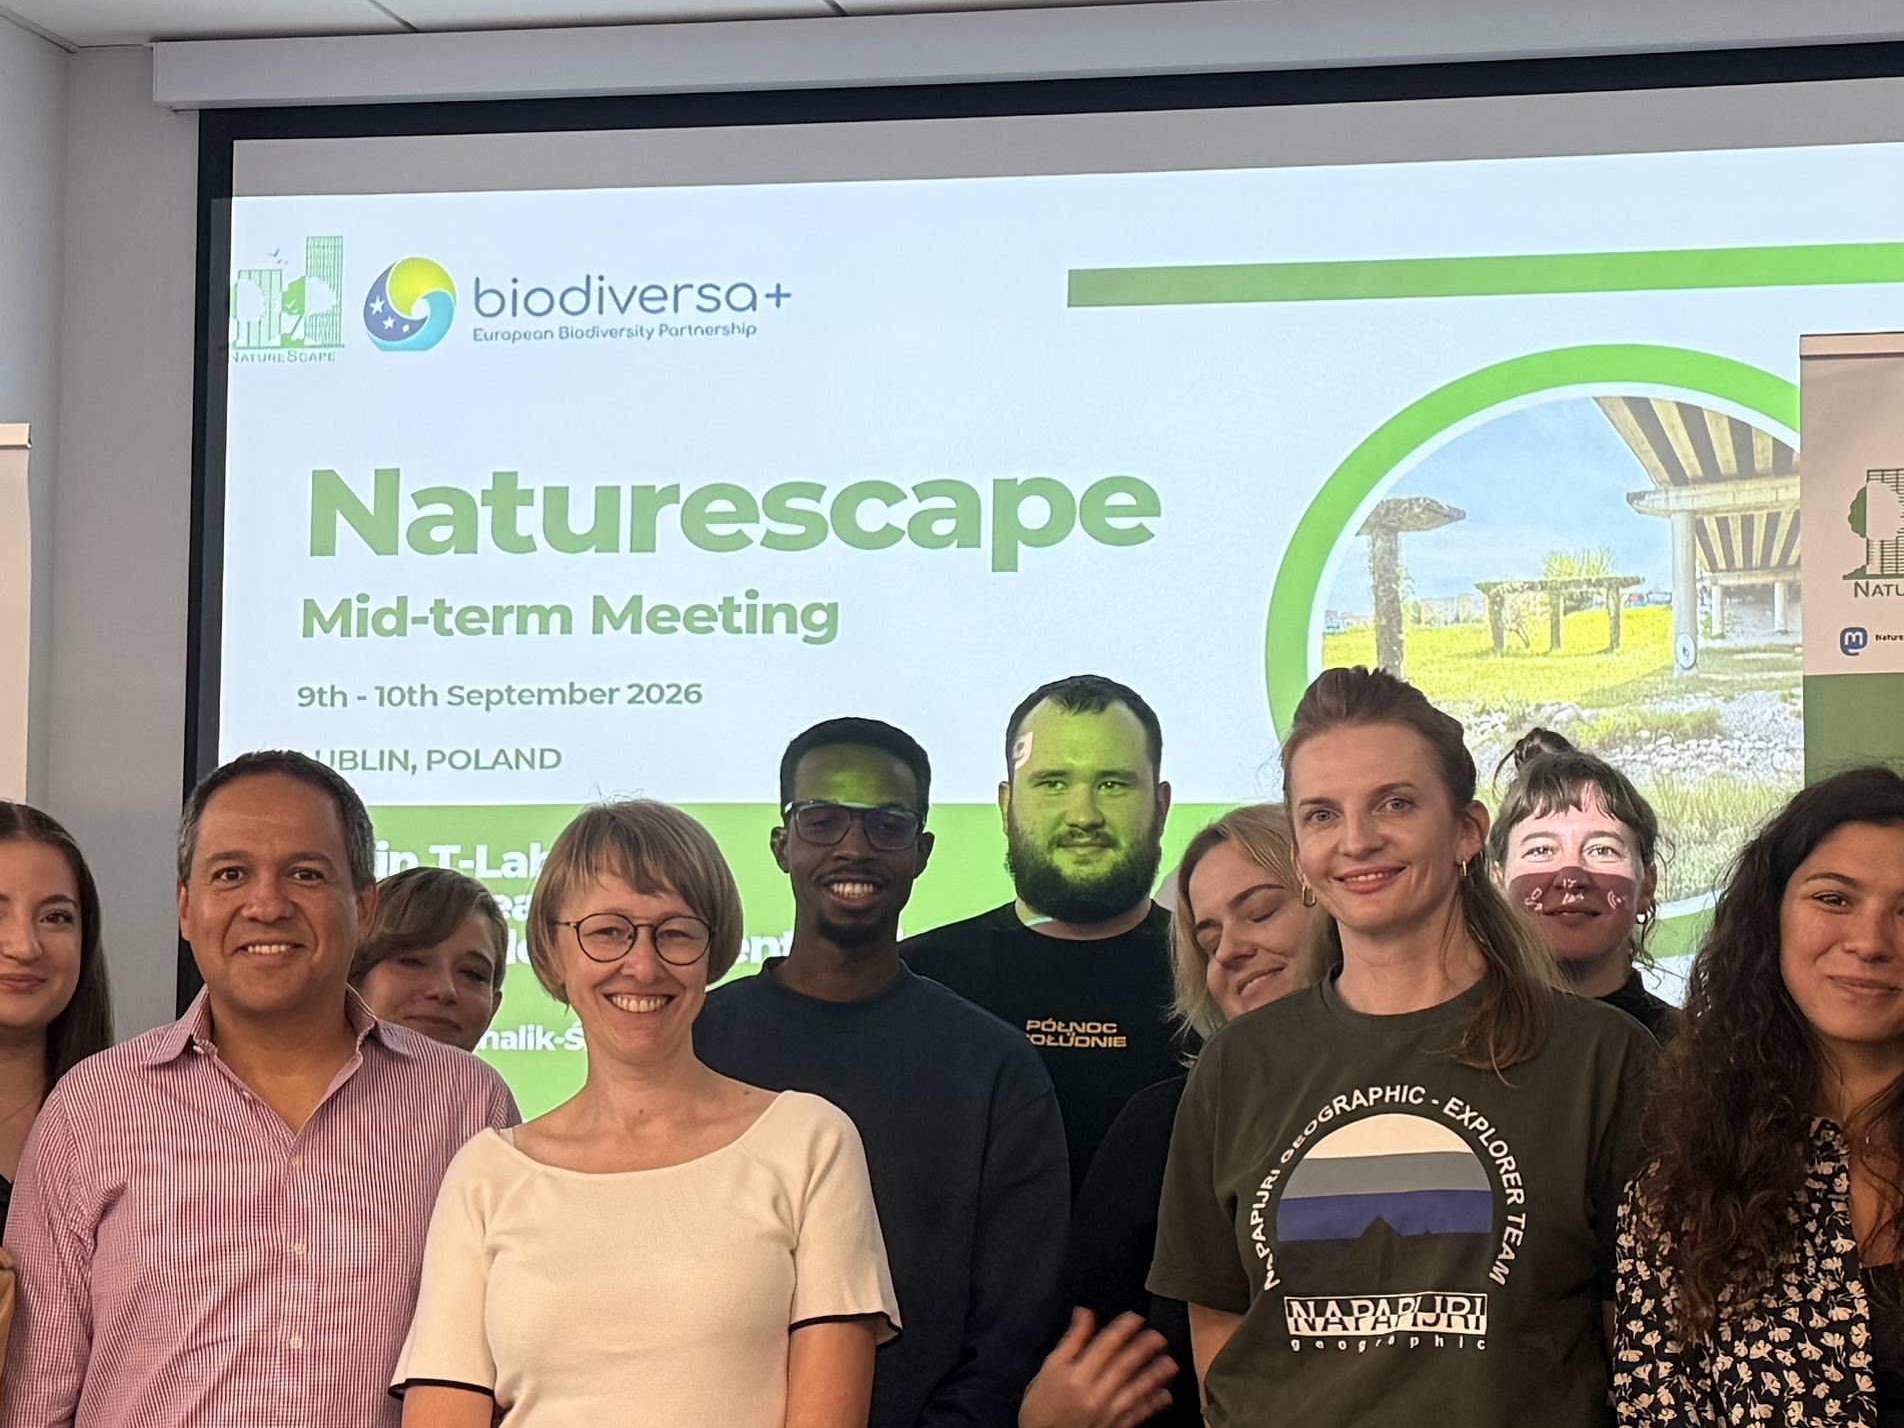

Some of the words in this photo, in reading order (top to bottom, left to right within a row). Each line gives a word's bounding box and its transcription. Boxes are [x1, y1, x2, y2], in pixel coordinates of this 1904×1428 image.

[472, 274, 792, 319] biodiversa+
[472, 327, 555, 345] European
[558, 323, 655, 341] Biodiversity
[658, 321, 758, 339] Partnership
[308, 467, 1162, 573] Naturescape
[301, 594, 573, 639] Mid-term
[592, 588, 840, 645] Meeting
[297, 684, 349, 708] 9th
[375, 684, 439, 708] 10th
[446, 682, 620, 712] September
[626, 682, 704, 706] 2026
[426, 748, 563, 771] POLAND
[1280, 1083, 1427, 1165] GEOGRAPHIC
[1442, 1095, 1526, 1207] EXPLORER
[1488, 1211, 1527, 1288] TEAM
[1286, 1294, 1485, 1334] NAPAPIJRI
